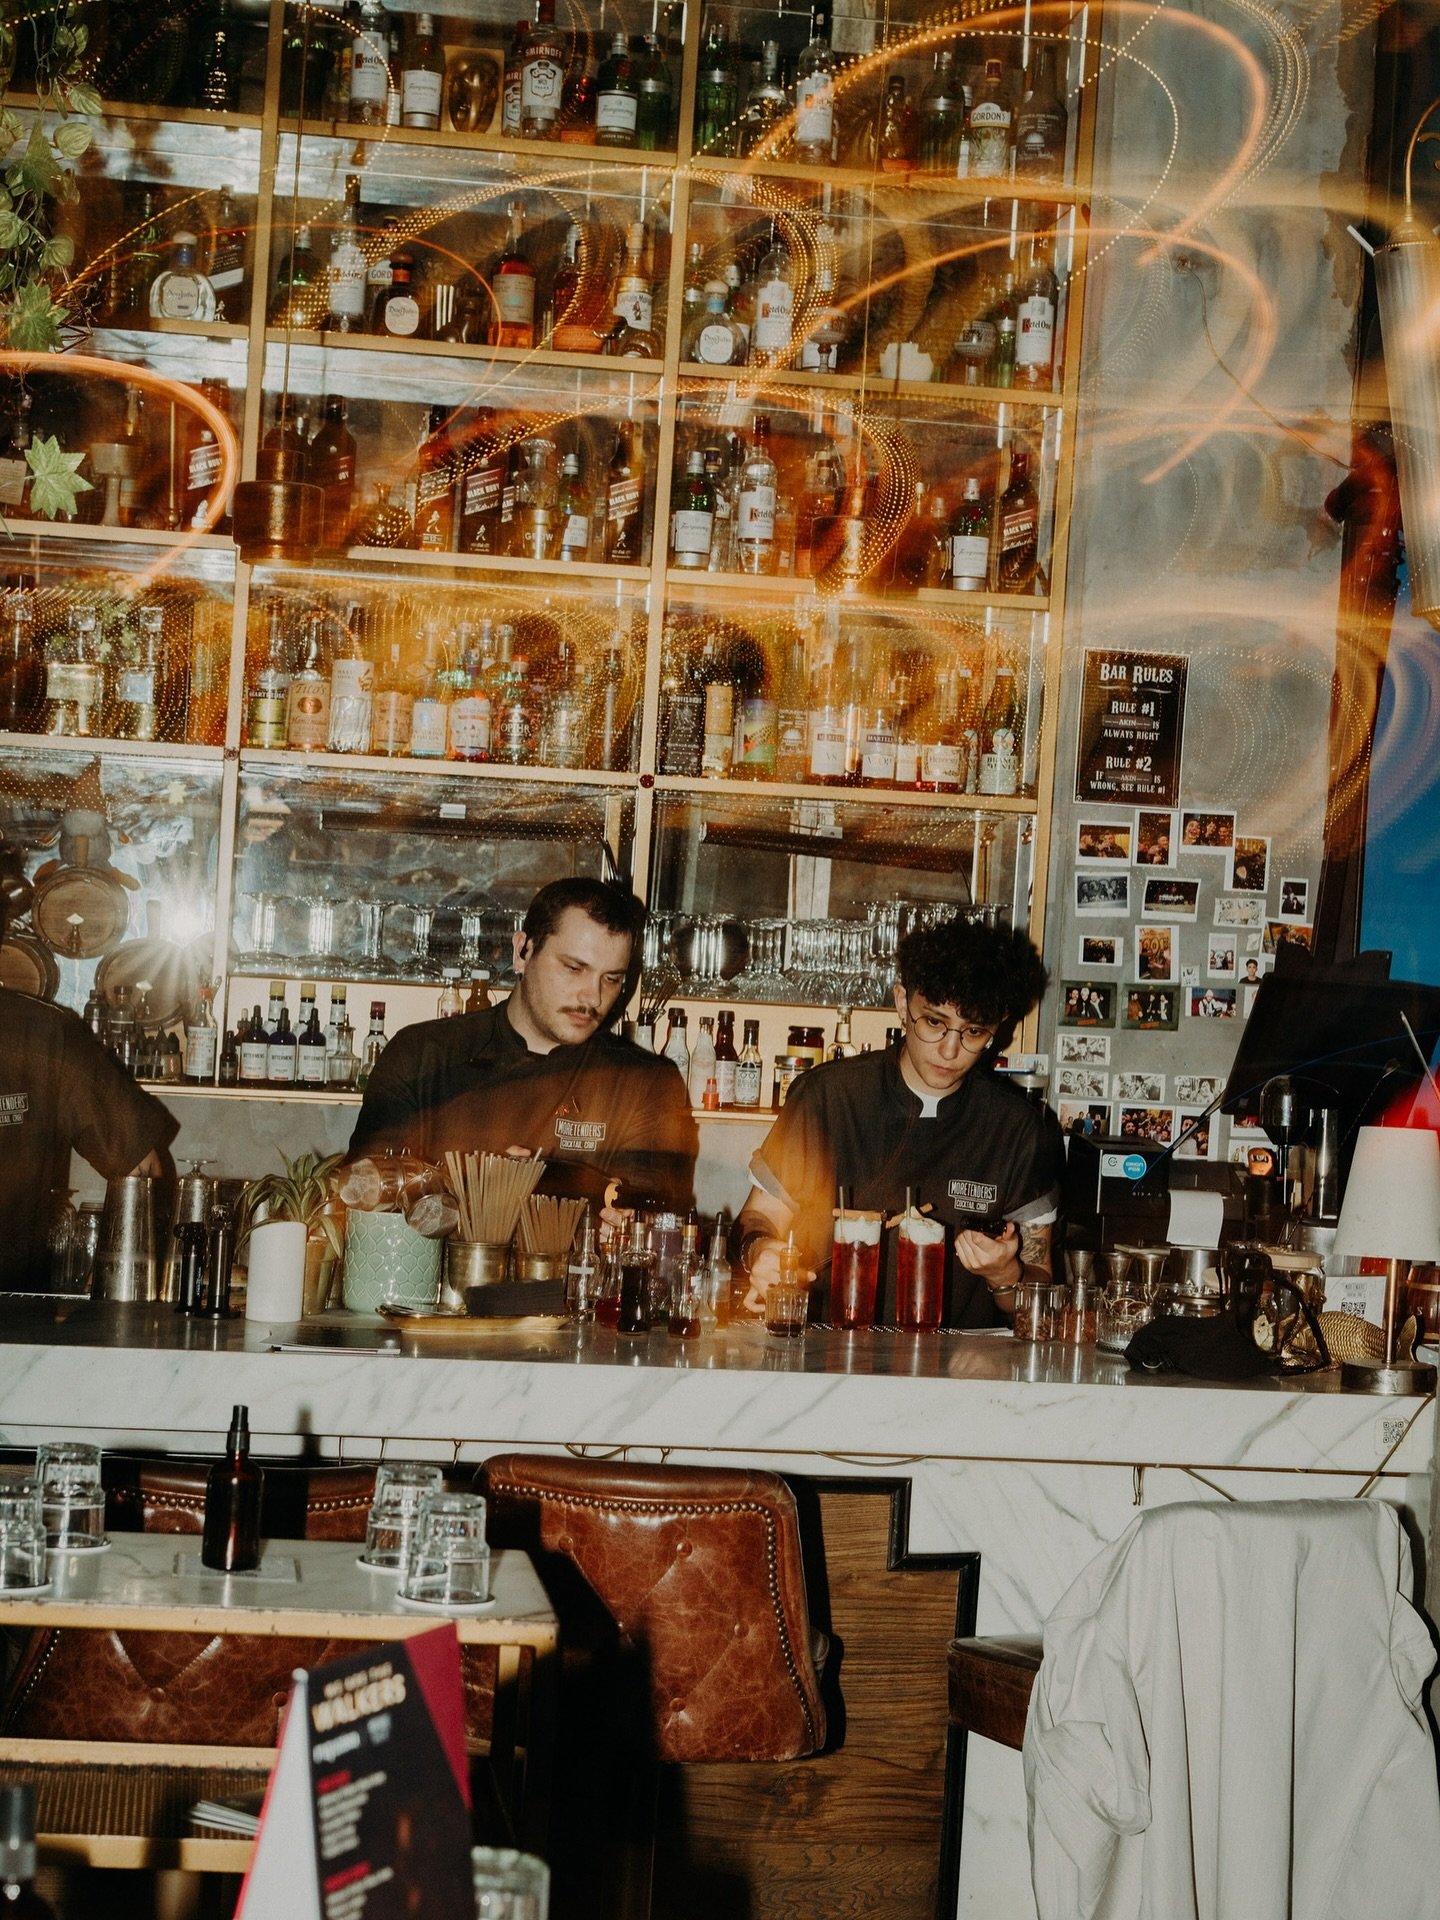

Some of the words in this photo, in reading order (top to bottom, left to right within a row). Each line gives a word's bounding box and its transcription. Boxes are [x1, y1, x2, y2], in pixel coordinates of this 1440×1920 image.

[525, 47, 562, 58] SMIRNOFF
[1141, 702, 1155, 717] #1
[1153, 721, 1160, 730] IS
[1103, 729, 1134, 739] ALWAYS
[1136, 731, 1160, 741] RIGHT
[1135, 756, 1152, 772] #2
[1154, 775, 1161, 784] IS
[1121, 783, 1134, 792] SEE
[1137, 784, 1155, 793] RULE
[1157, 785, 1165, 794] #1
